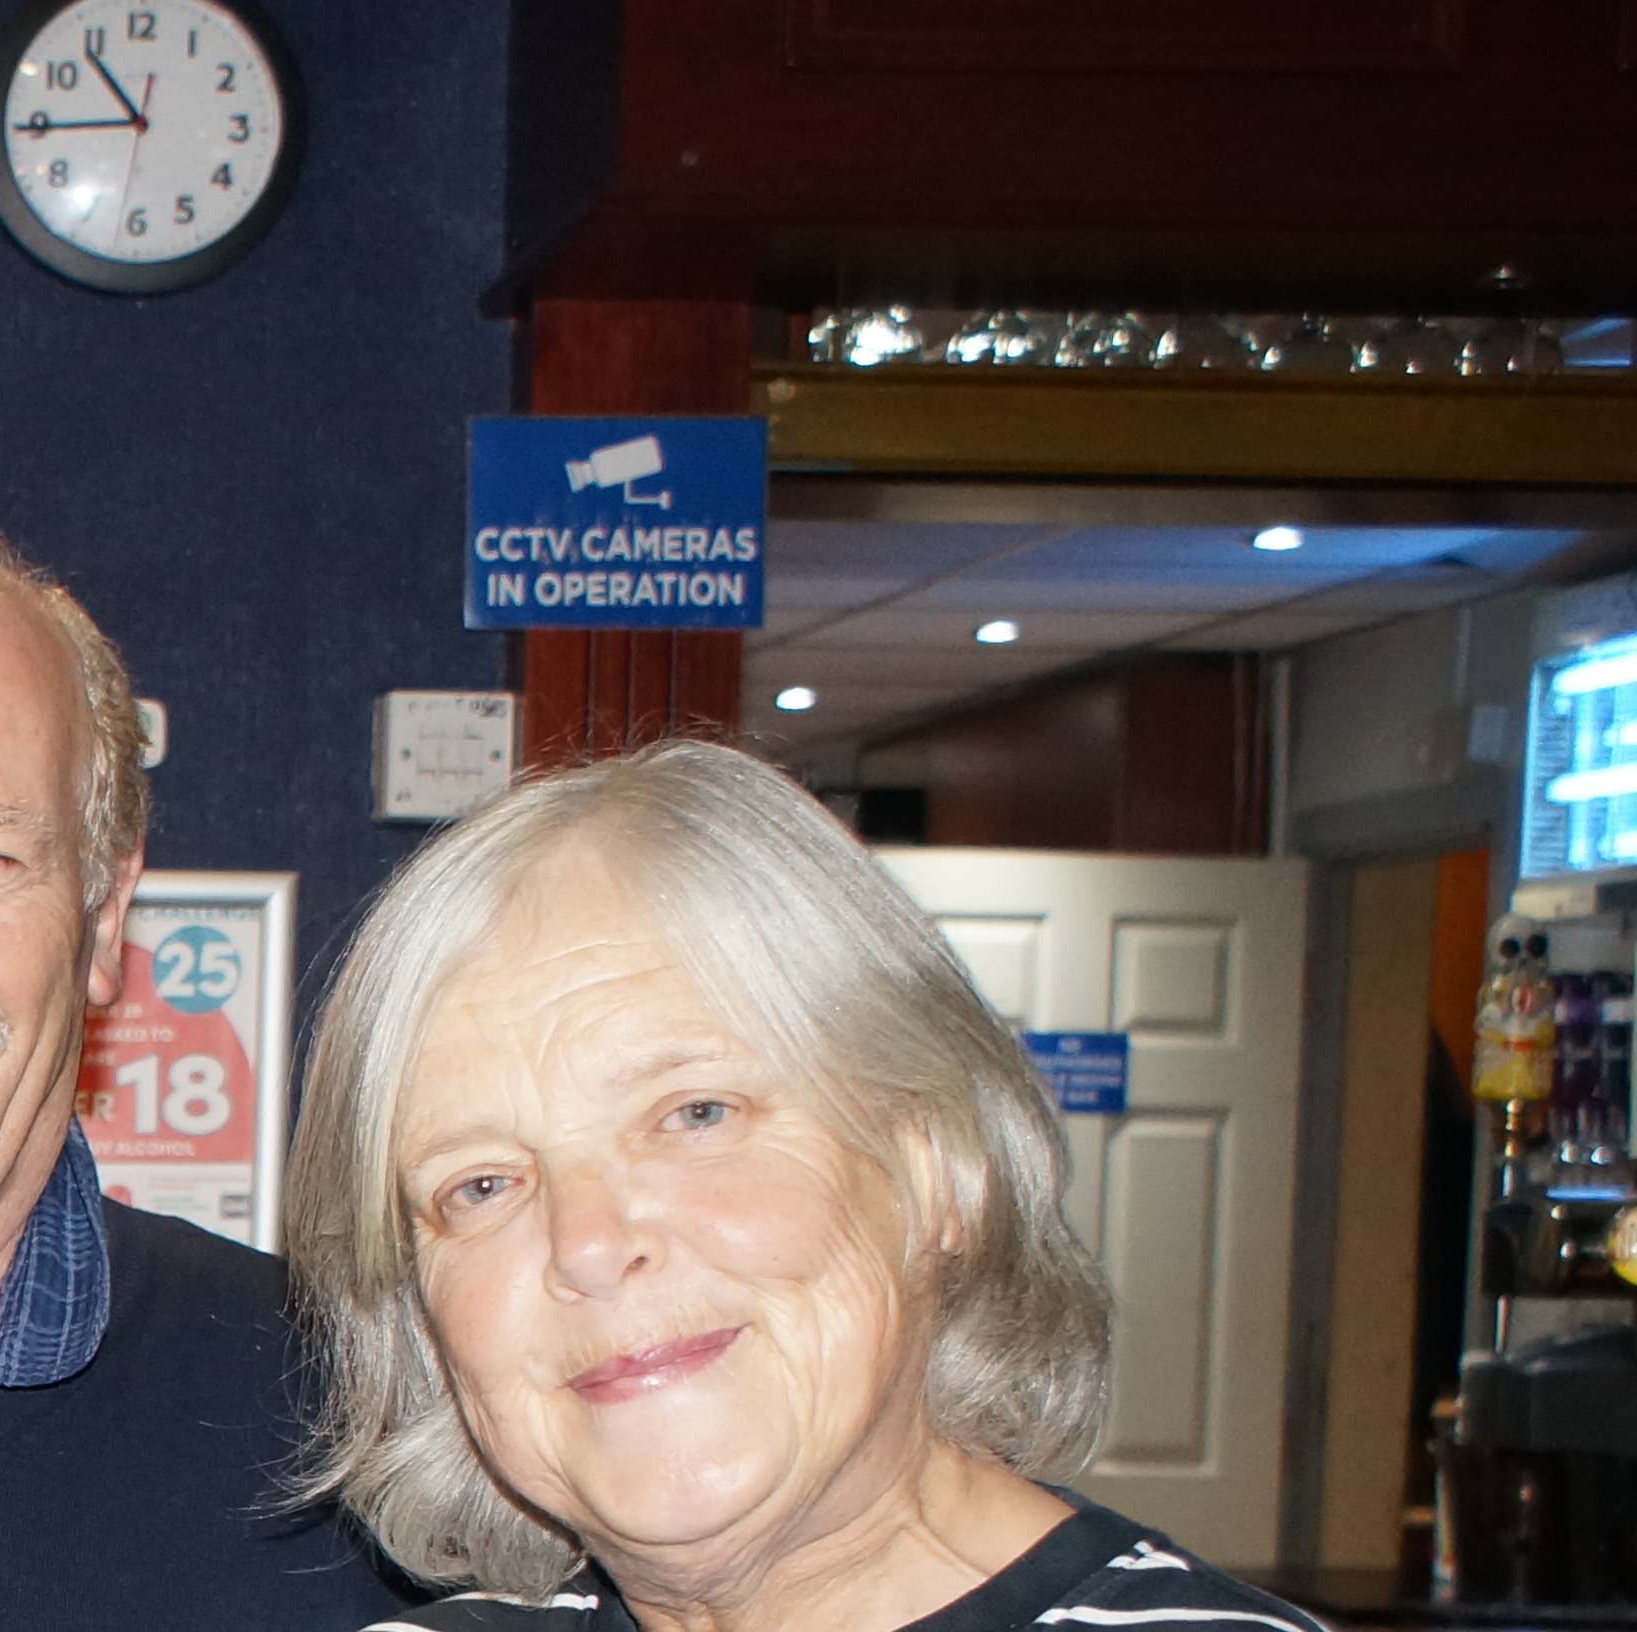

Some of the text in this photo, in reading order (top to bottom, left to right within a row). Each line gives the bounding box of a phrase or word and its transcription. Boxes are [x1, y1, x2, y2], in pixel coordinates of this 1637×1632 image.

[128, 12, 156, 40] 12
[85, 28, 105, 56] 11
[187, 29, 197, 58] 1
[46, 61, 78, 90] 10
[216, 63, 236, 92] 2
[29, 112, 49, 140] 9
[228, 113, 251, 143] 3
[48, 159, 69, 188] 8
[210, 162, 234, 191] 4
[127, 209, 148, 238] 6
[174, 194, 195, 225] 5
[474, 526, 757, 563] CCTV CAMERAS
[487, 571, 745, 608] IN OPERATION
[157, 941, 239, 998] 25
[116, 1053, 232, 1136] 18
